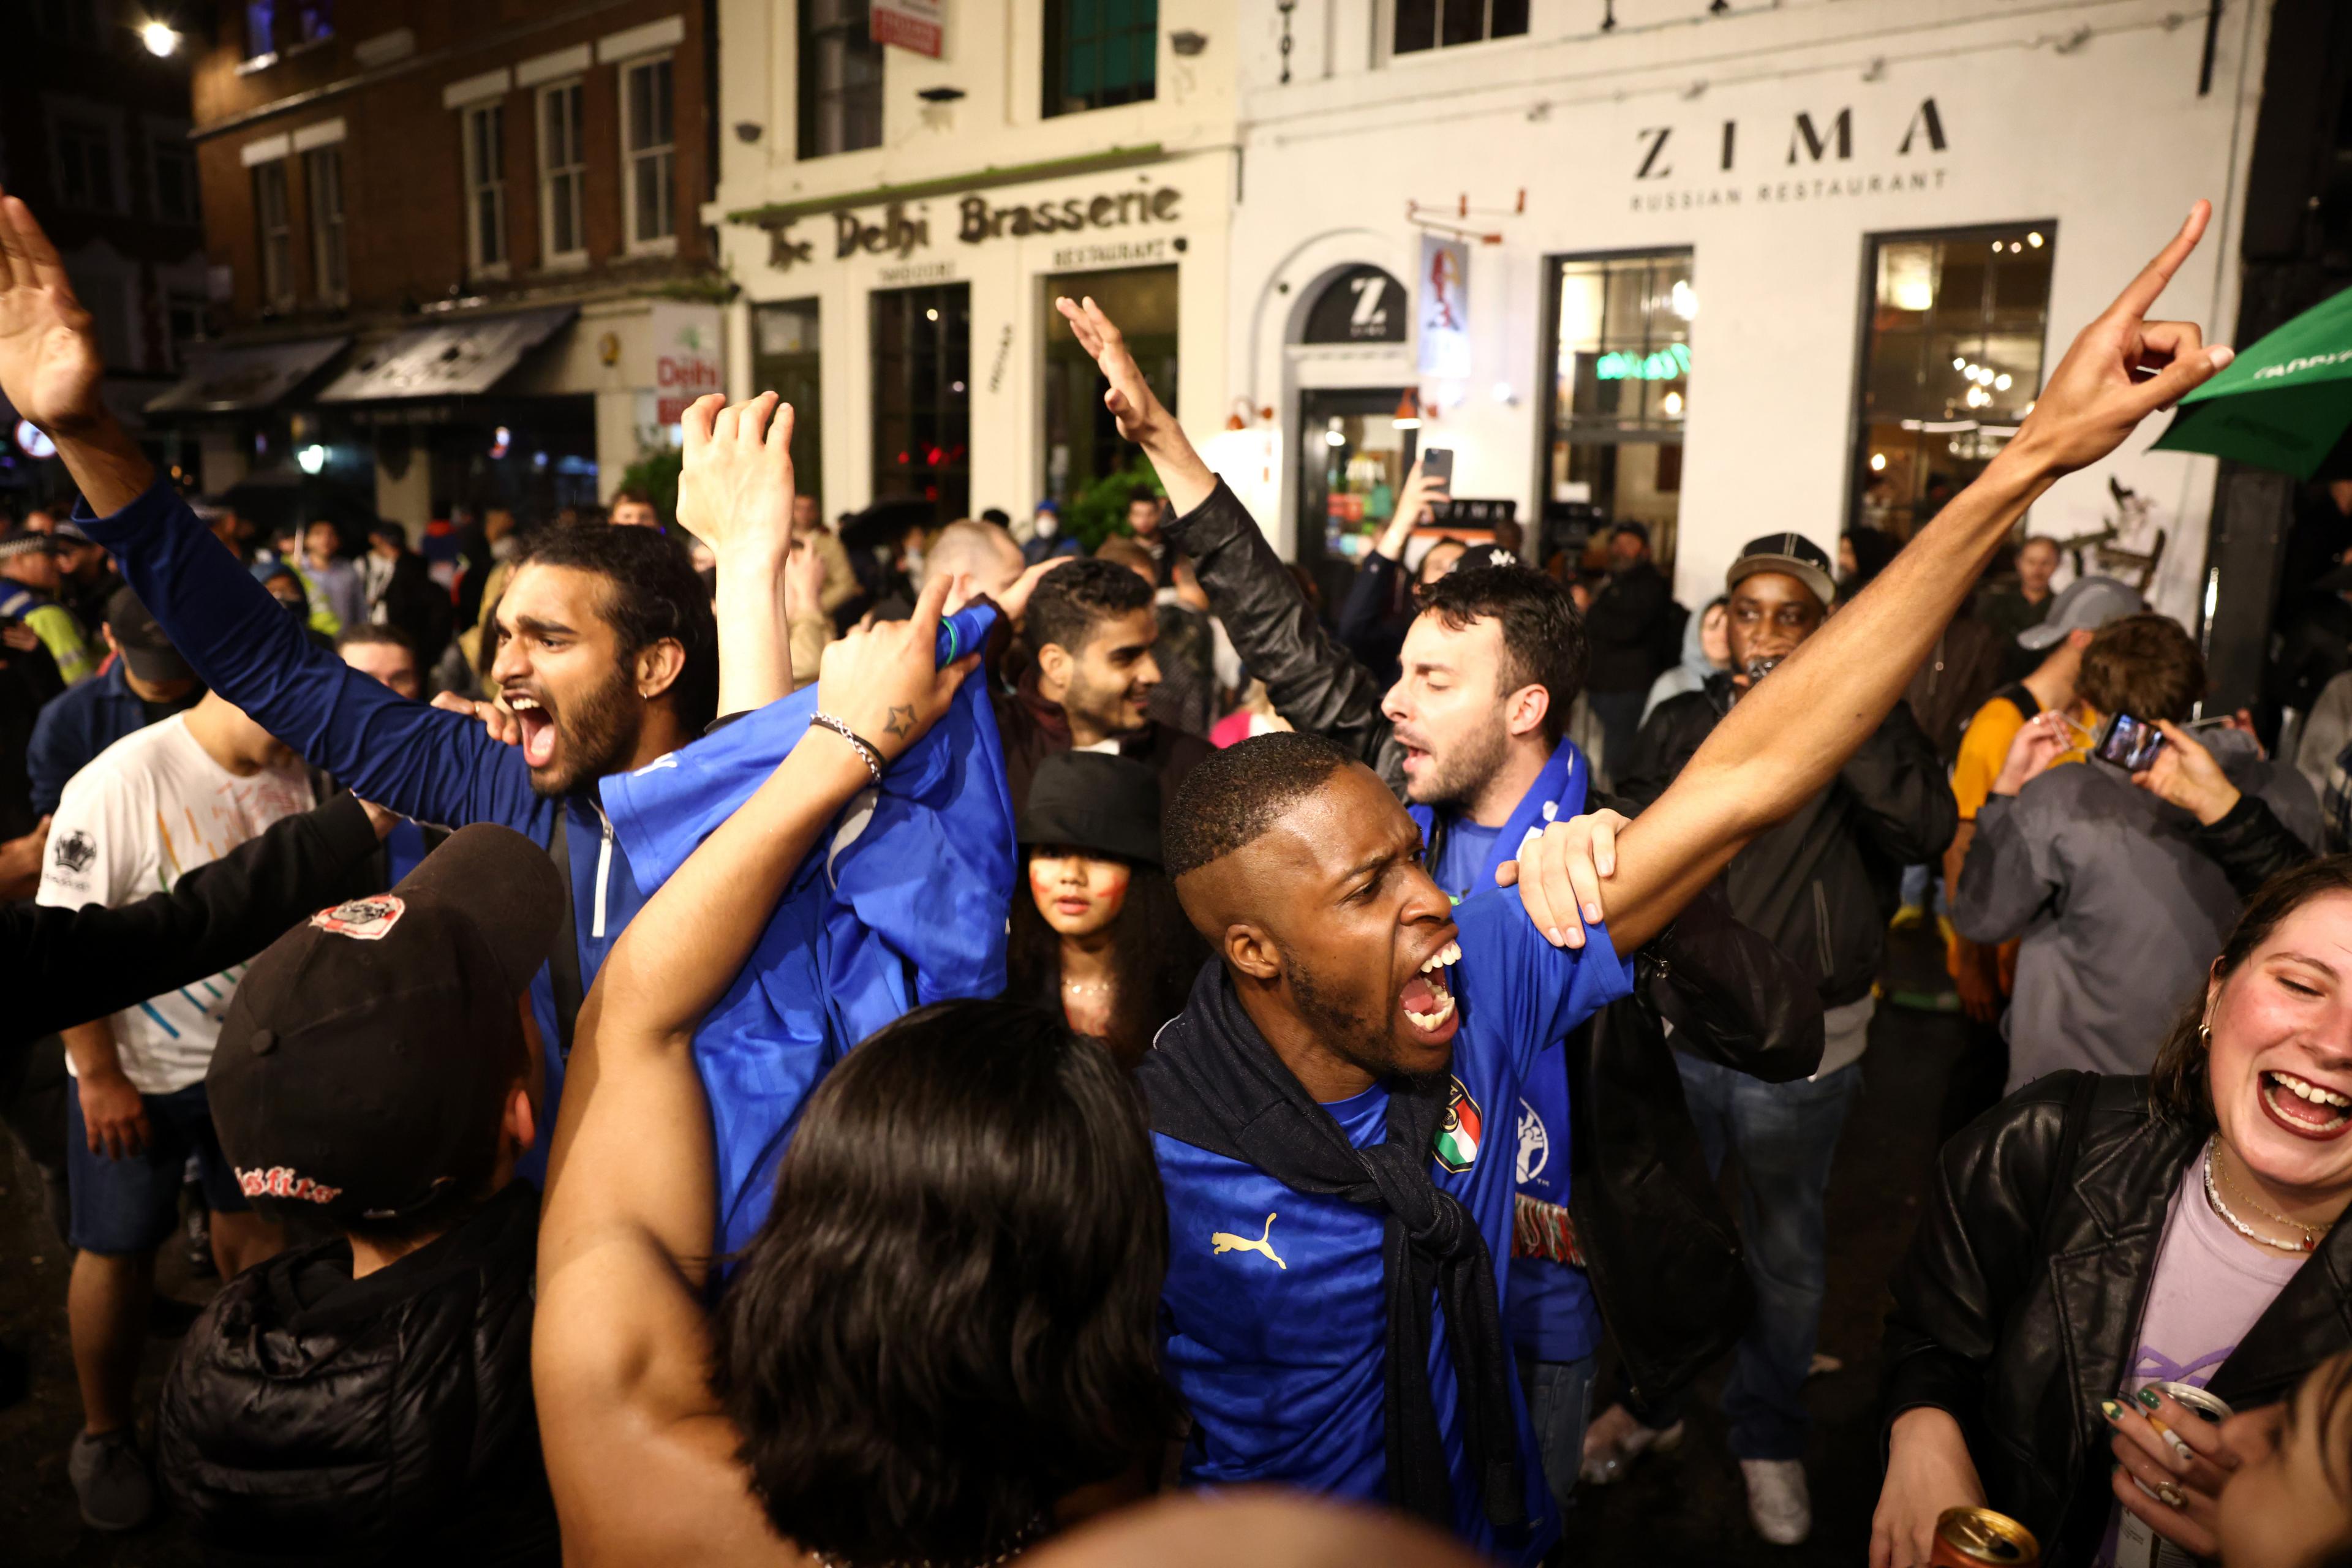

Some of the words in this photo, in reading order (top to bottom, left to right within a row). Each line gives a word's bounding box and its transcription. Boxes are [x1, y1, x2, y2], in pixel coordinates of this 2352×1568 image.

[1635, 95, 1950, 179] ZIMA
[1630, 187, 1741, 213] RUSSIAN
[1756, 169, 1948, 203] RESTAURANT
[759, 219, 813, 273] The
[833, 201, 930, 259] Delhi
[958, 175, 1182, 244] Brasserie
[1054, 238, 1165, 265] RESTAURANT
[1351, 276, 1387, 325] Z
